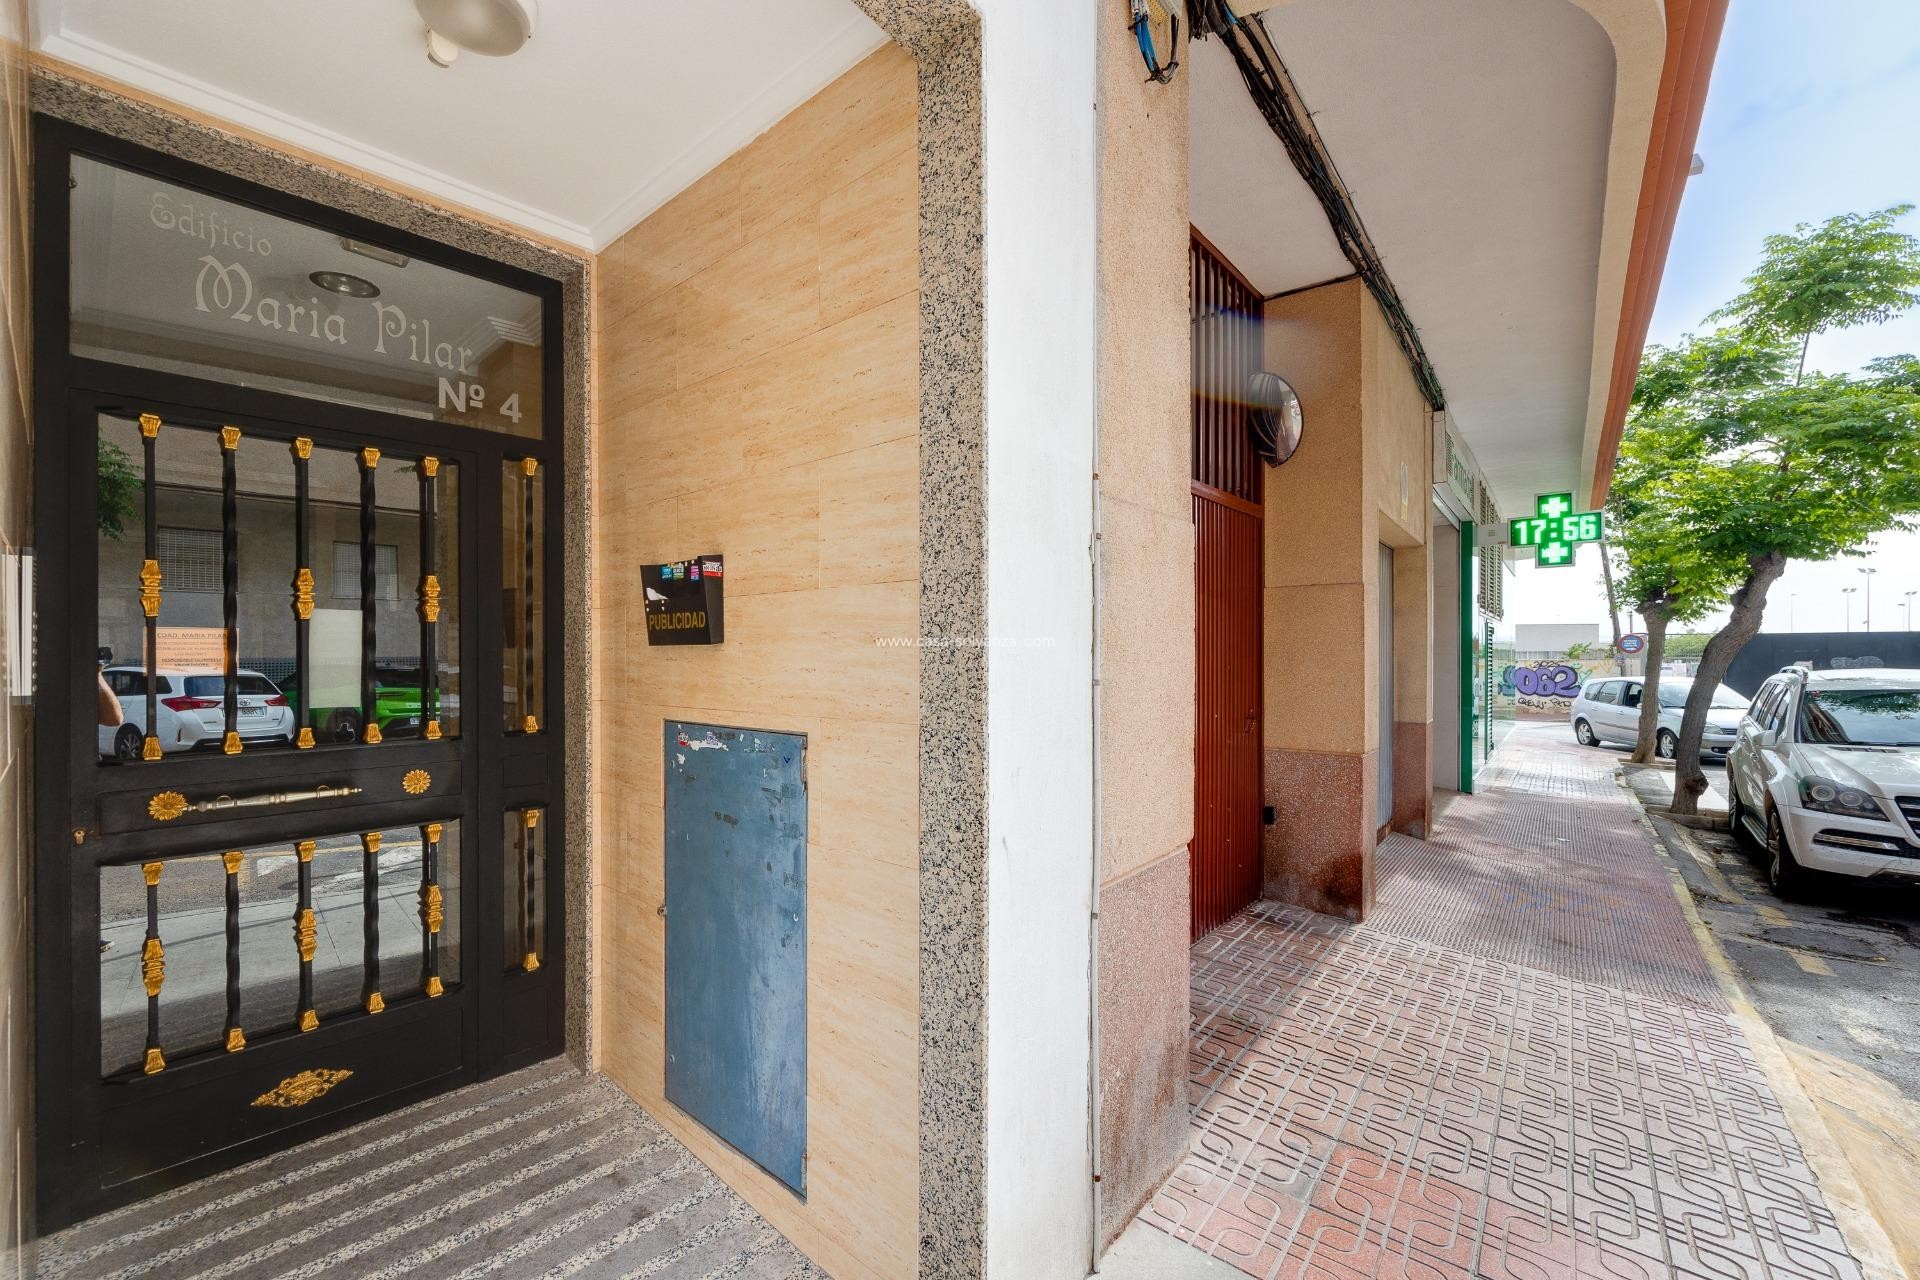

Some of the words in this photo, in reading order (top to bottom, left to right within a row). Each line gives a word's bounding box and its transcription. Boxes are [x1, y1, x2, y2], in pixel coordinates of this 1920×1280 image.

[150, 191, 272, 257] Edificio
[195, 255, 347, 346] Maria
[373, 301, 472, 373] Pilar
[499, 393, 522, 423] 4
[1515, 515, 1595, 544] 17:56
[649, 612, 706, 631] PUBLICIDAD
